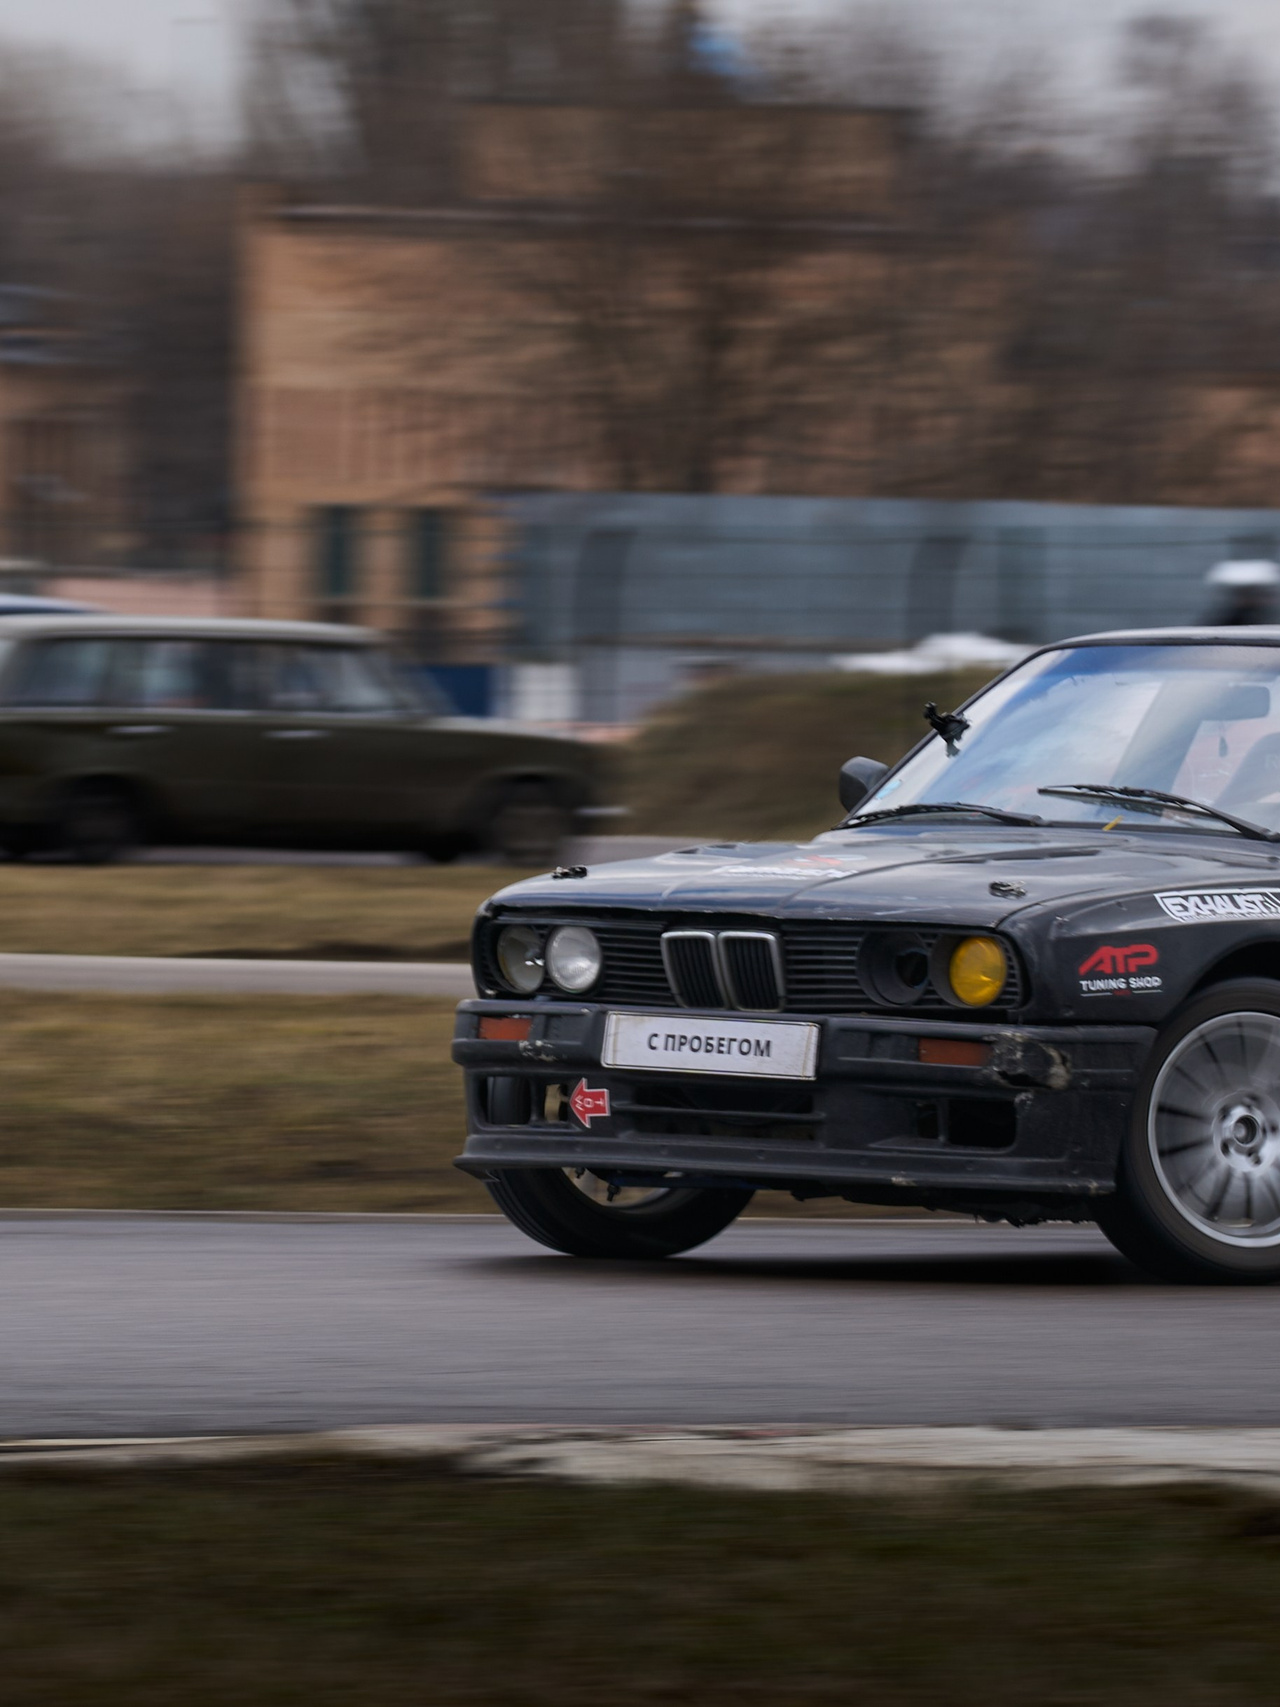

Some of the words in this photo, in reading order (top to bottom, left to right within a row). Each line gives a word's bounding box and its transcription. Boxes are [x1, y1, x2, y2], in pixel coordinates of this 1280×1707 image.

[1161, 893, 1270, 916] EXHAUST
[1079, 944, 1159, 976] ATP
[1079, 978, 1128, 992] TUNING
[1128, 976, 1163, 989] SHOP
[646, 1032, 659, 1051] С
[664, 1033, 773, 1058] ПРОБЕГОМ
[574, 1095, 606, 1111] TOW
